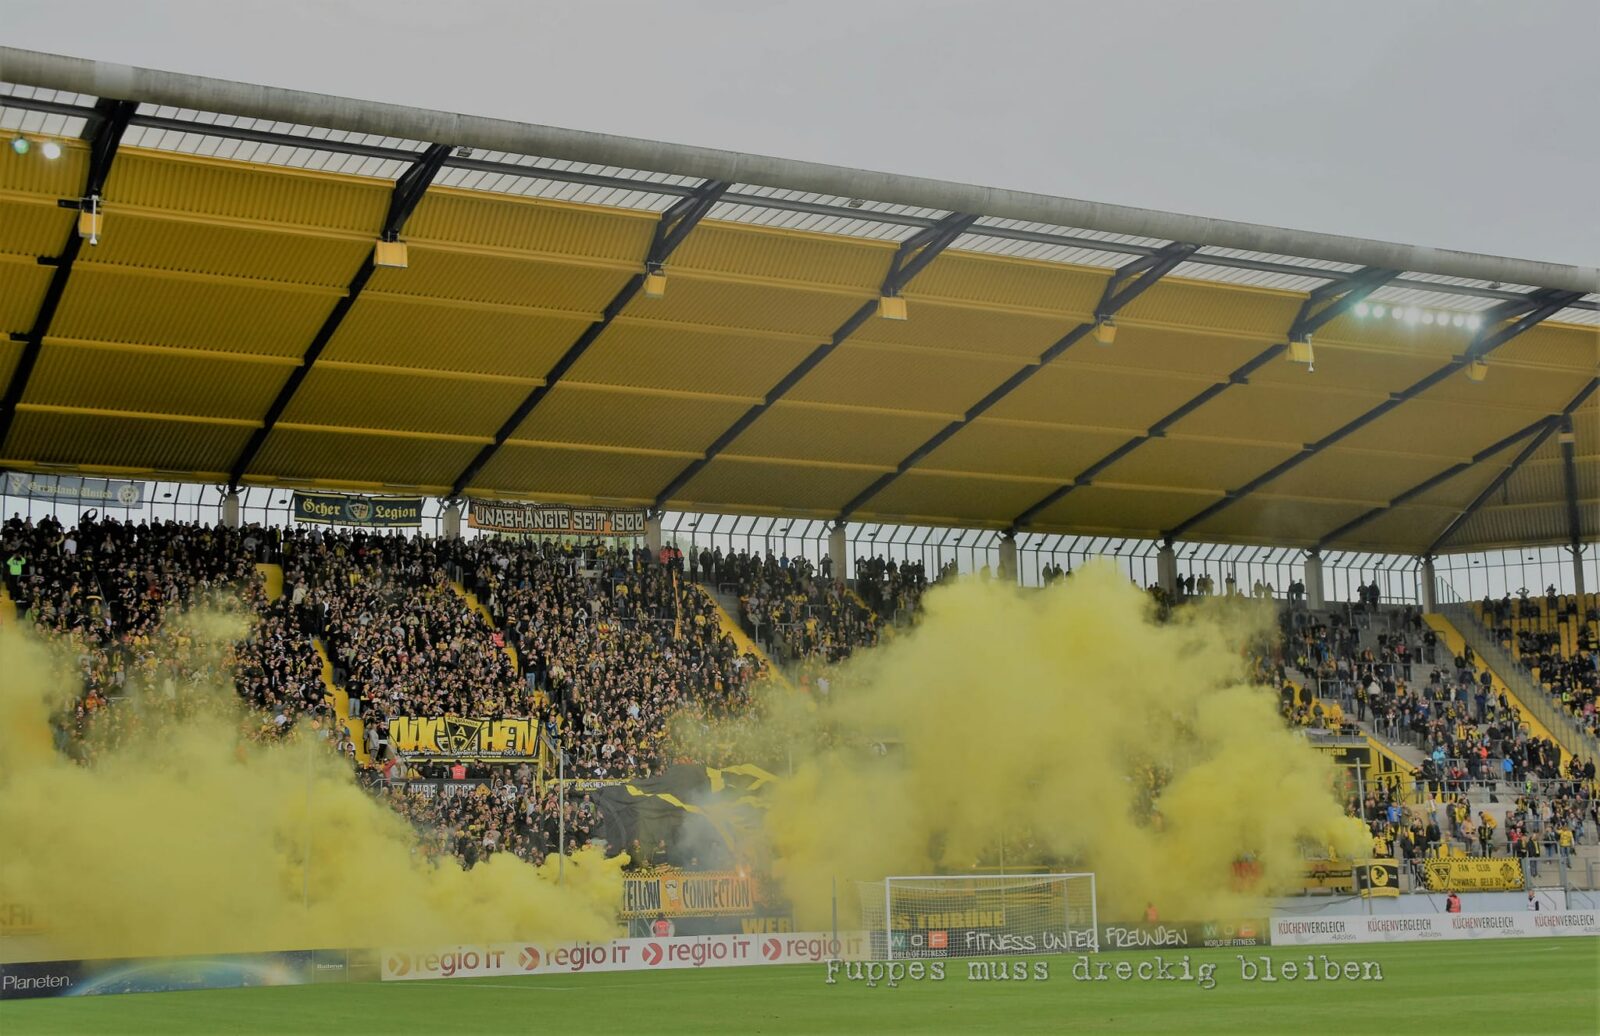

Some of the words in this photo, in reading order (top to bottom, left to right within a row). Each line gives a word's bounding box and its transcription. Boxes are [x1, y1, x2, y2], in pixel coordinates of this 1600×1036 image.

[303, 498, 341, 516] Öcher
[375, 505, 417, 520] Legion
[474, 504, 569, 530] UNABHÄNGIG
[573, 510, 608, 531] SEIT
[610, 512, 645, 532] 1900
[682, 879, 750, 908] CONNECTION
[1278, 920, 1345, 935] KÜCHENVERGLEICH
[1367, 918, 1432, 932] KÜCHENVERGLEICH
[1452, 915, 1514, 929] KÜCHENVERGLEICH
[1534, 913, 1595, 928] KÜCHENVERGLEICH
[787, 934, 841, 961] regio
[965, 931, 1036, 950] FITNESS
[1042, 928, 1099, 950] UNTER
[1105, 926, 1188, 947] FREUNDEN
[546, 941, 606, 971] regio
[668, 937, 727, 966] regio
[2, 975, 73, 990] Planeten.
